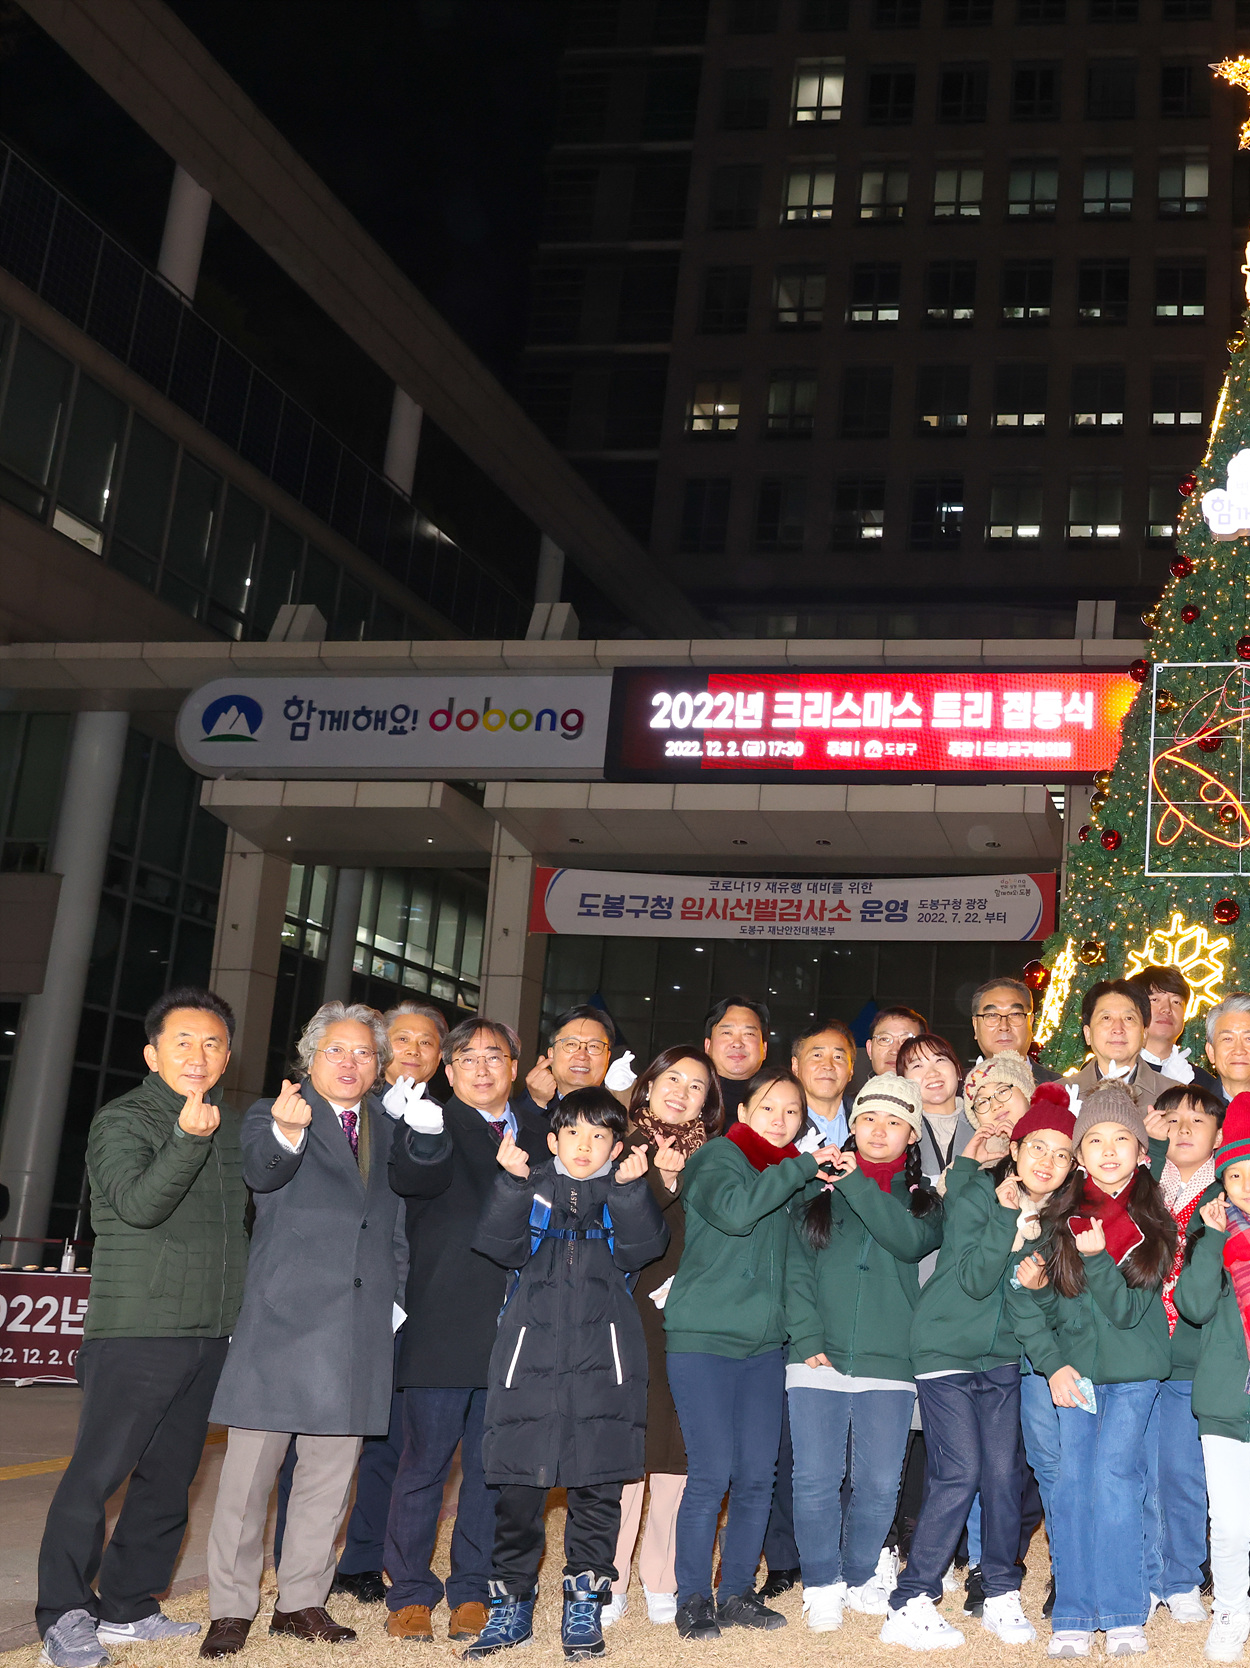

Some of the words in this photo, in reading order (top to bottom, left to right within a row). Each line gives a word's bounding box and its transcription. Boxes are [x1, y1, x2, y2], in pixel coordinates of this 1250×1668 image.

[283, 695, 418, 742] 함께해요!
[429, 697, 585, 741] dobong
[650, 692, 764, 729] 2022년
[772, 692, 922, 728] 크리스마스
[931, 692, 992, 729] 트리
[1003, 692, 1093, 730] 점등식
[665, 741, 703, 757] 2022.
[706, 741, 725, 757] 12.
[727, 741, 740, 757] 2.
[768, 741, 804, 757] 17:30
[708, 880, 761, 893] 코로나19
[765, 881, 803, 894] 재유행
[806, 882, 843, 895] 대비를
[848, 882, 873, 895] 위한
[577, 893, 674, 920] 도봉구청
[680, 897, 851, 922] 임시선별검사소
[860, 899, 909, 923] 운영
[918, 898, 962, 910] 도봉구청
[965, 898, 988, 910] 광장
[917, 913, 948, 924] 2022.
[951, 913, 961, 924] 7.
[964, 913, 982, 924] 22.
[985, 912, 1007, 924] 부터
[739, 925, 765, 935] 도봉구
[767, 926, 835, 936] 재난안전대책본부
[22, 1348, 44, 1364] 12.
[48, 1349, 63, 1365] 2.
